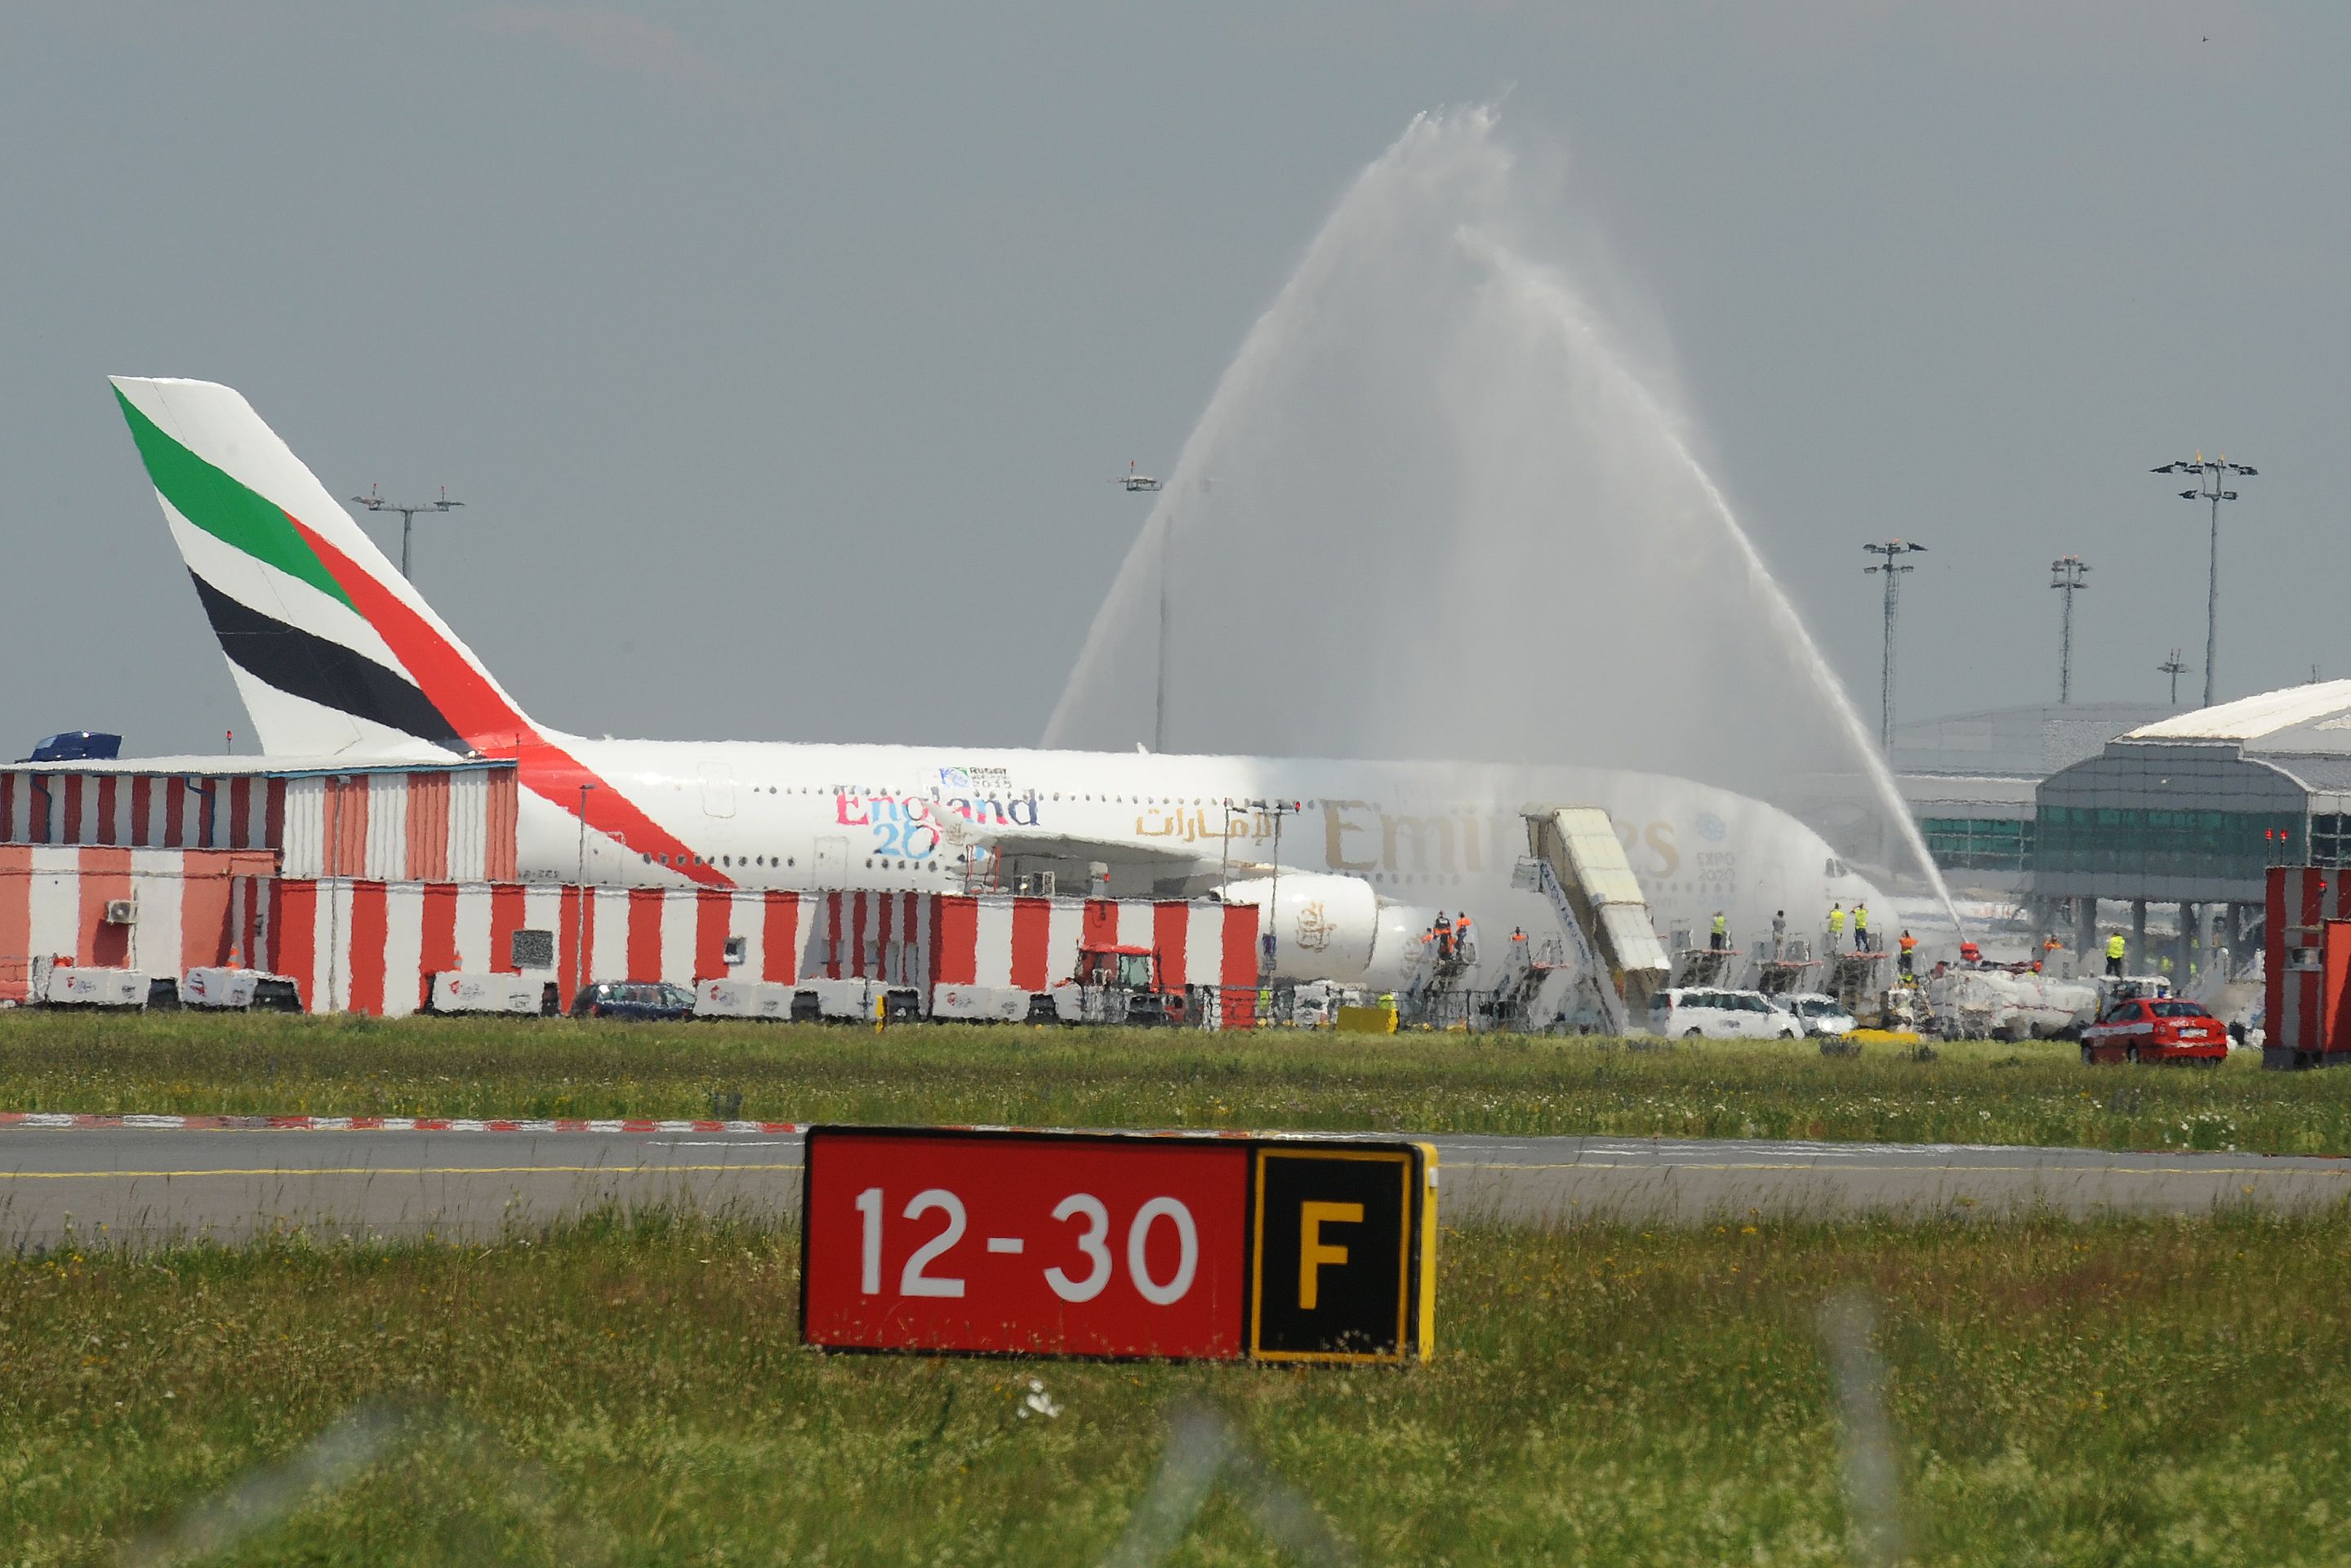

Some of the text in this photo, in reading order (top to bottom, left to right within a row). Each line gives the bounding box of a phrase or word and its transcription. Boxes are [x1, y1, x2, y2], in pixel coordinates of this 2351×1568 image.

[1320, 799, 1680, 879] Emirs
[1697, 852, 1735, 866] EXPO
[1698, 868, 1735, 882] 2020
[855, 1187, 1199, 1305] 12-30
[1299, 1200, 1364, 1310] F
